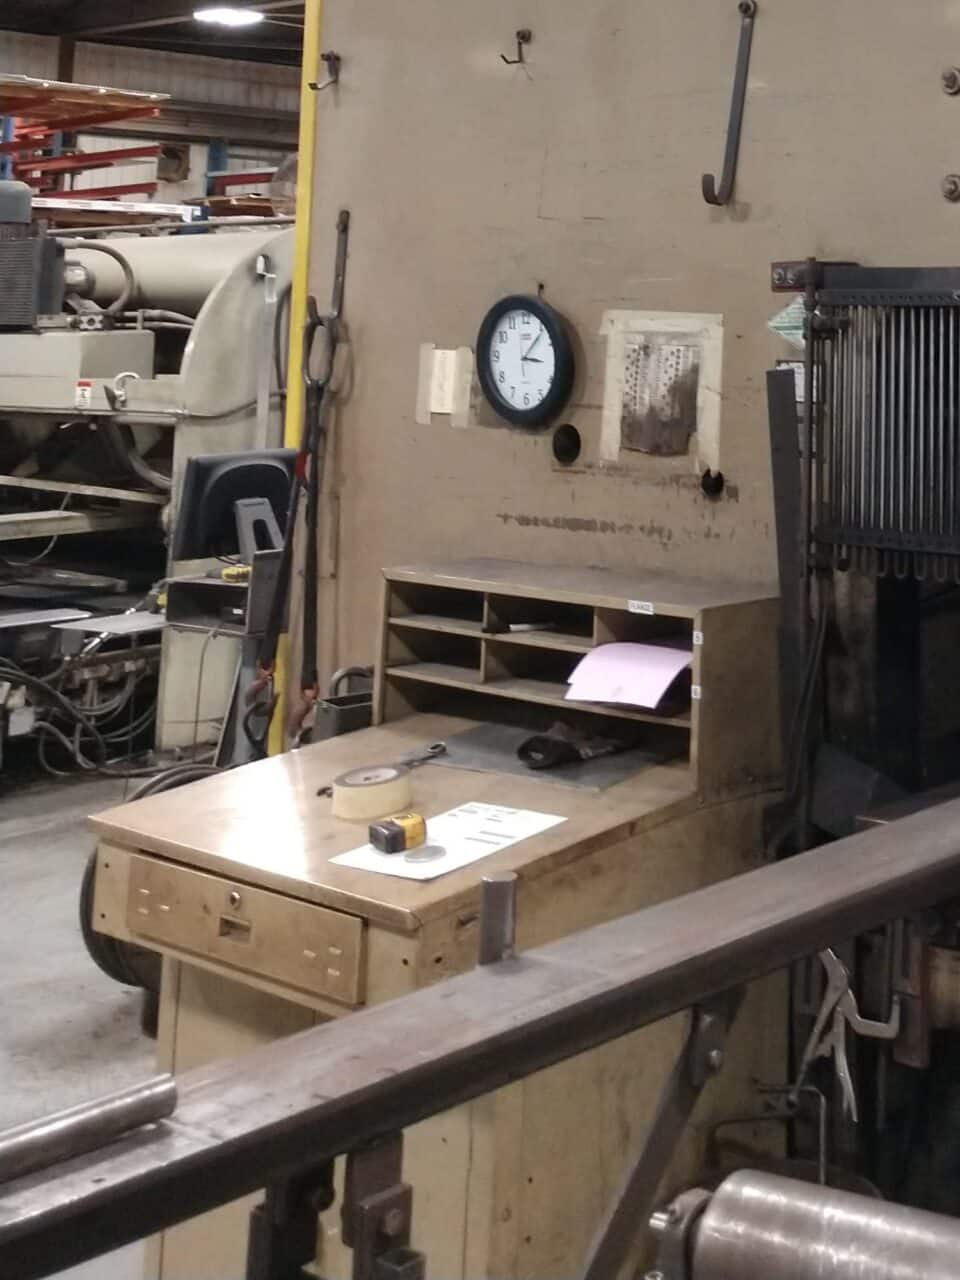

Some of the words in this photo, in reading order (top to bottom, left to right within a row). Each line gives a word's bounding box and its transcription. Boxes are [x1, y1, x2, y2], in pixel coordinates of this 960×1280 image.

[508, 315, 517, 330] 11
[521, 311, 531, 325] 12
[498, 330, 508, 344] 10
[493, 350, 500, 363] 9
[498, 370, 506, 384] 8
[510, 385, 516, 399] 7
[523, 392, 530, 406] 6
